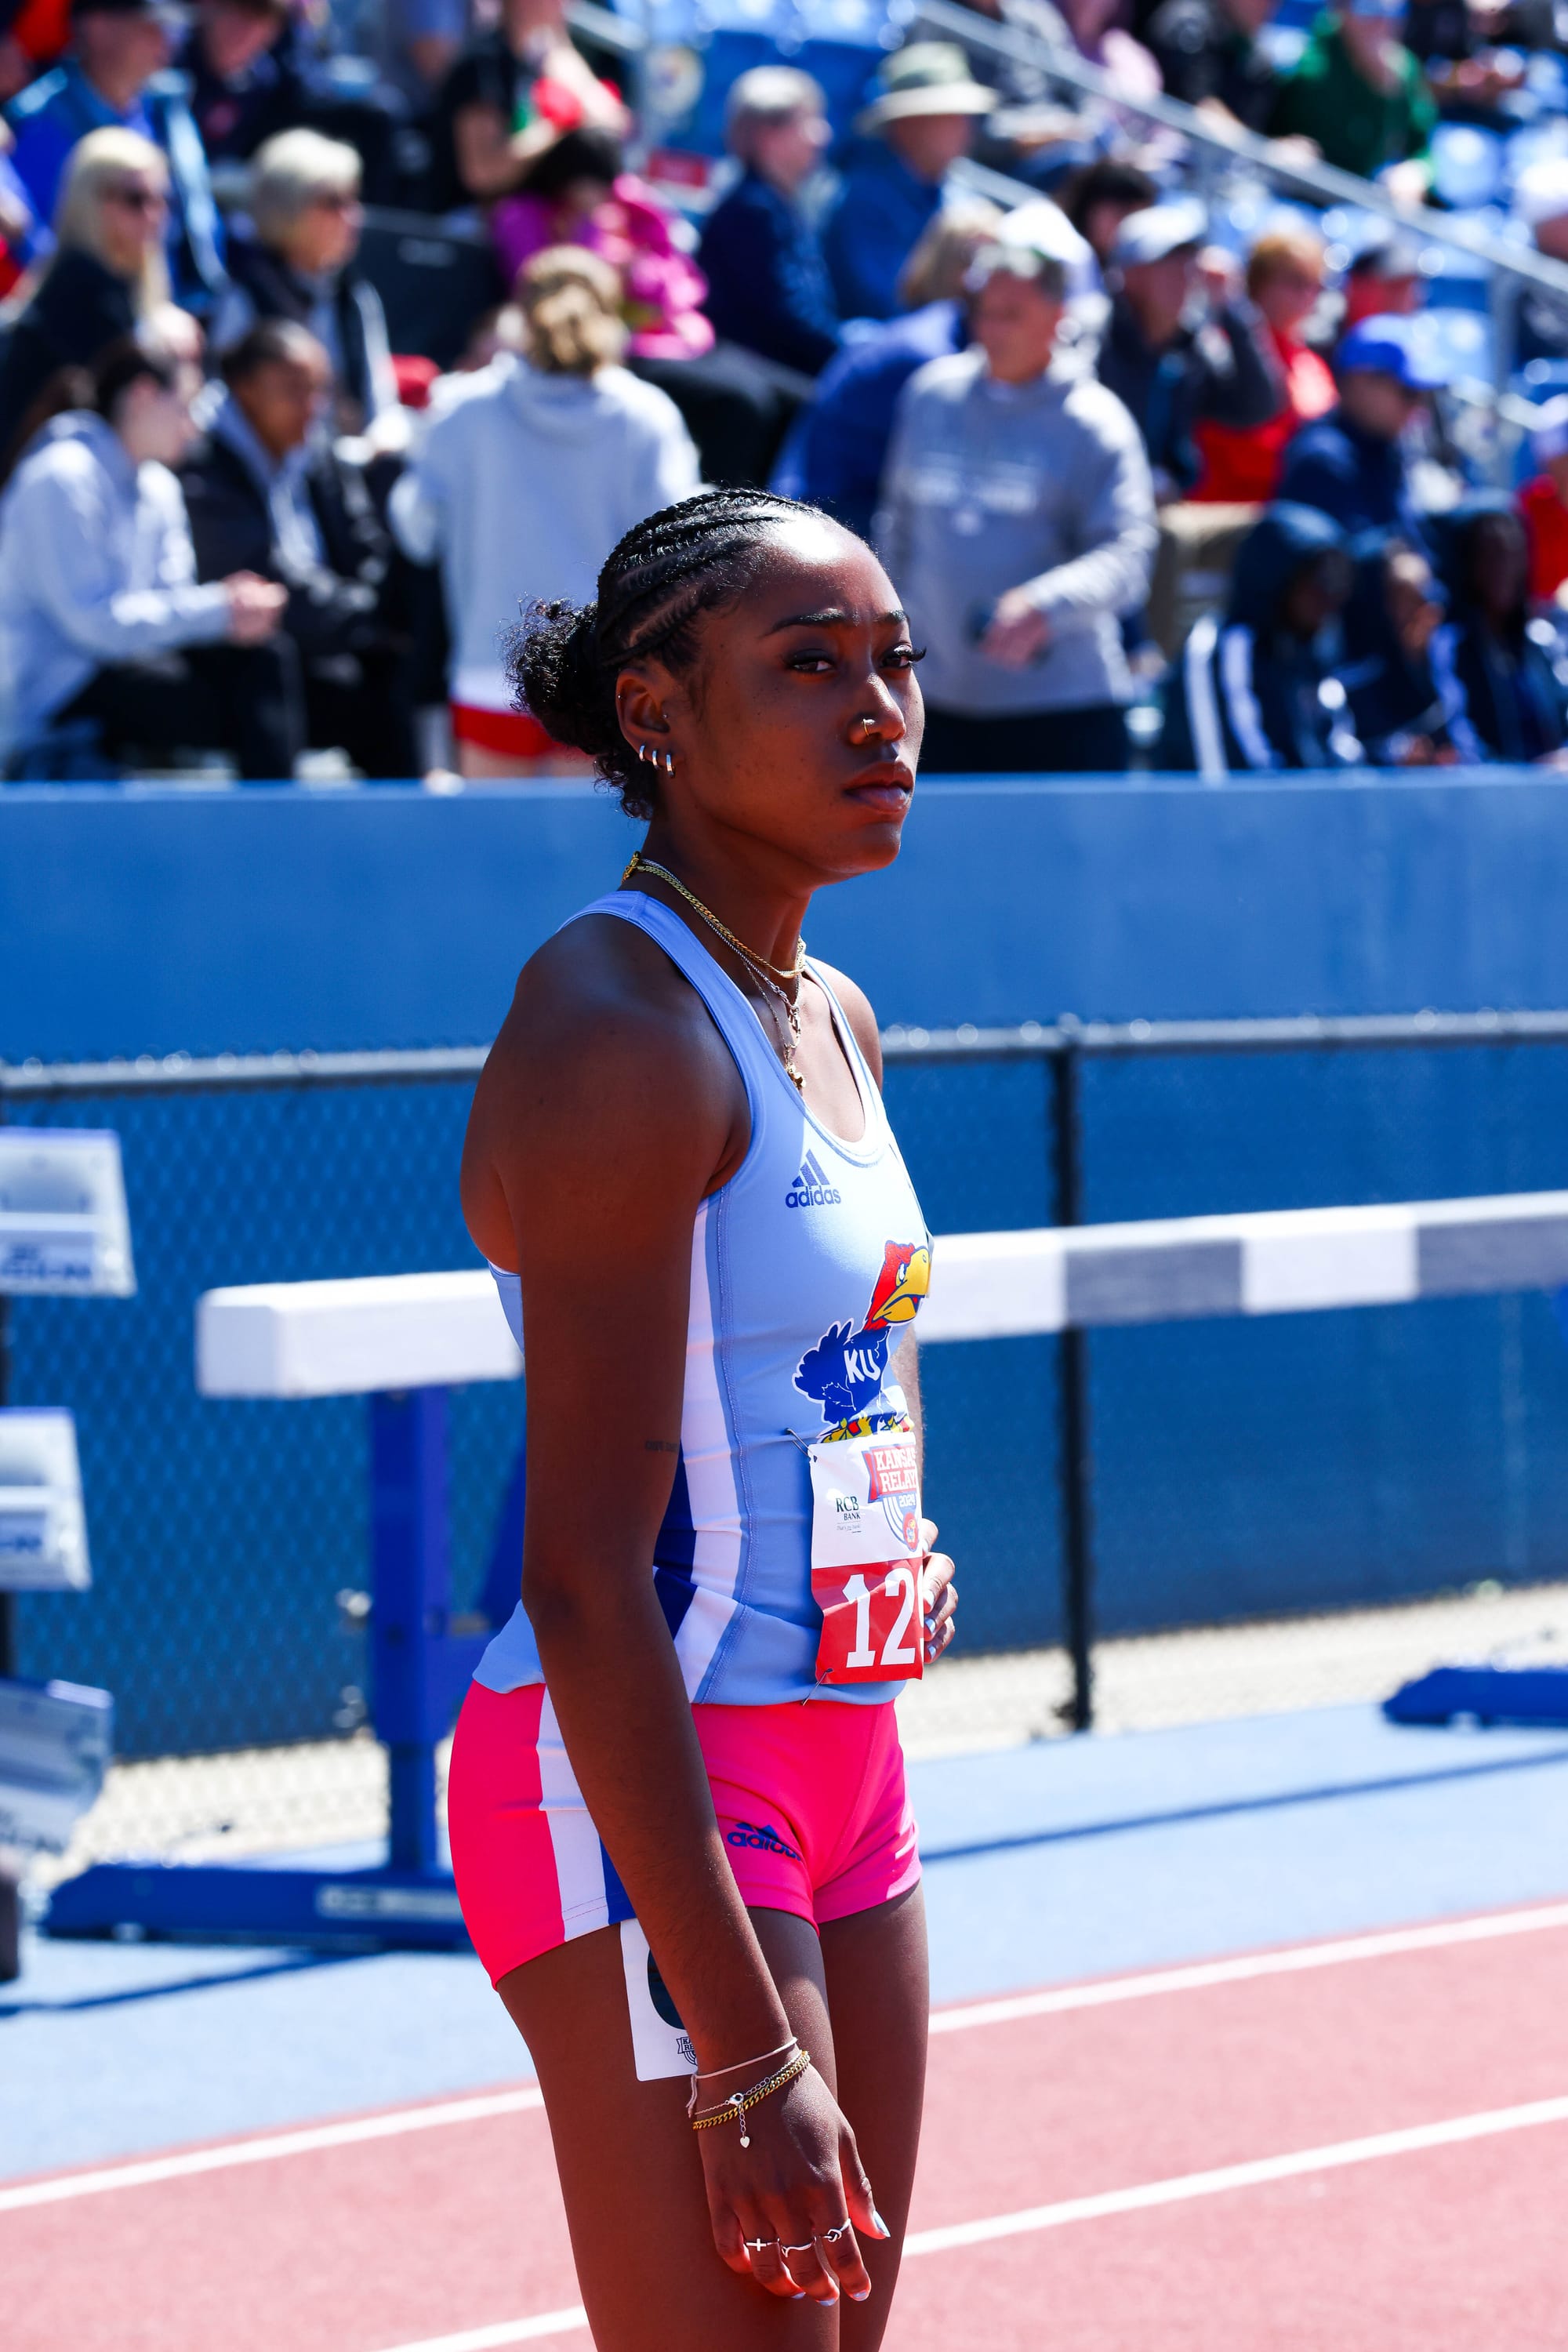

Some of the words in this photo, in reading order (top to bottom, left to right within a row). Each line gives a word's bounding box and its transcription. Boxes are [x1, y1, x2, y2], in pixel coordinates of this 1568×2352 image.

[785, 1185, 841, 1208] adidas
[844, 1348, 881, 1384] KU
[836, 1496, 859, 1512] RCB
[844, 1512, 861, 1521] BANK
